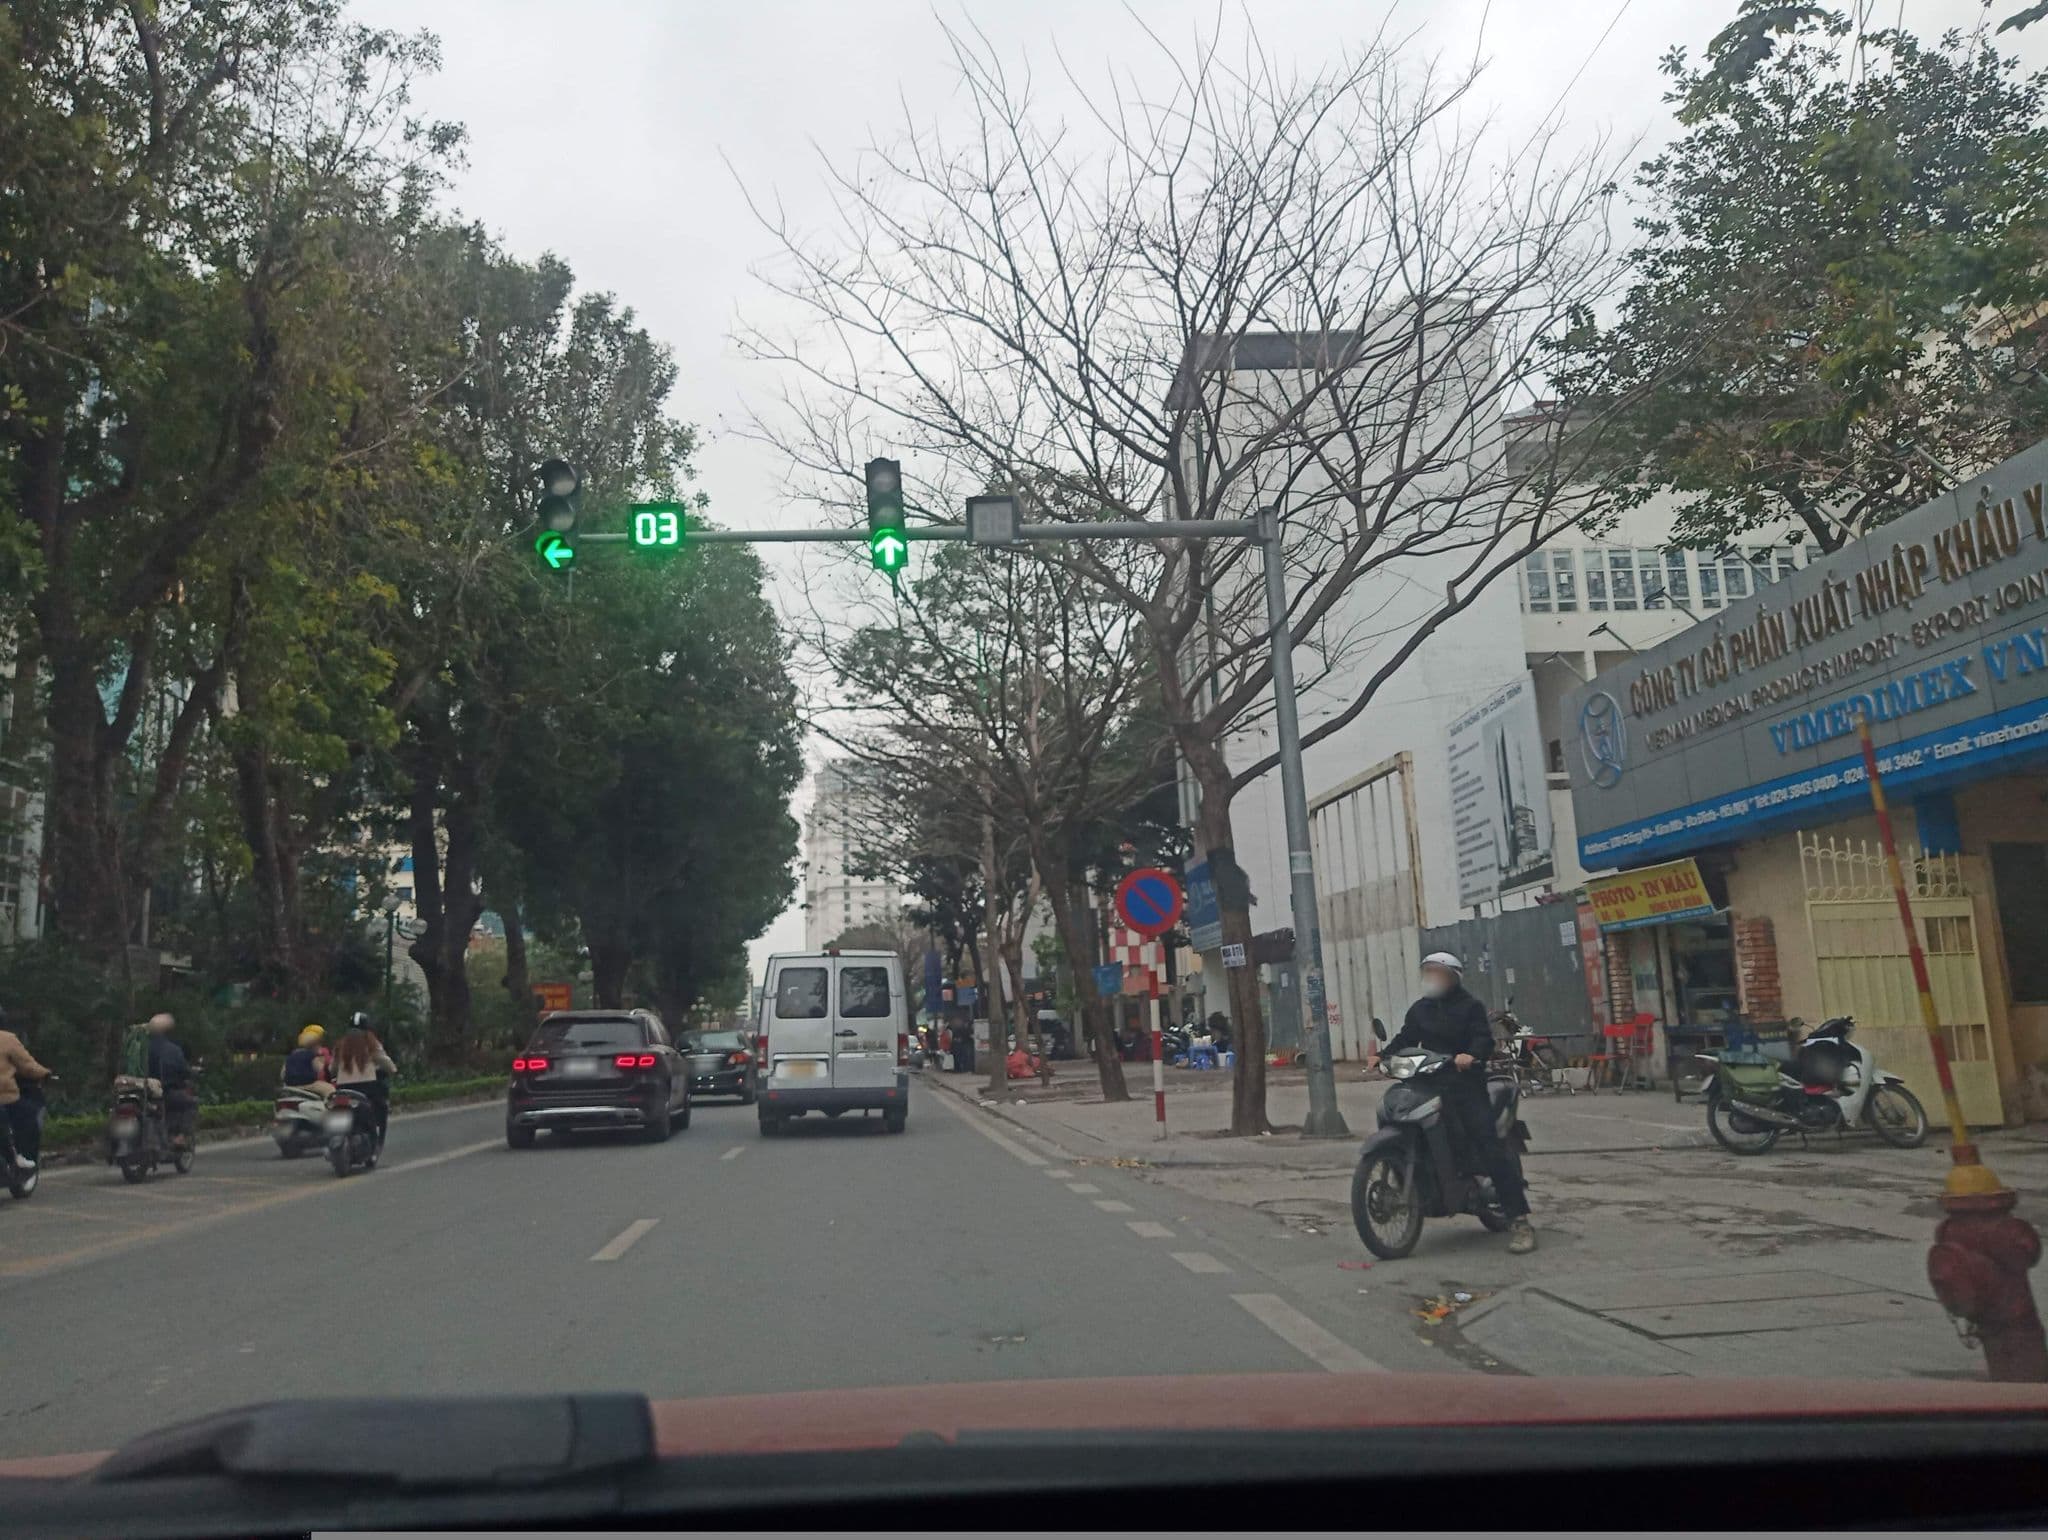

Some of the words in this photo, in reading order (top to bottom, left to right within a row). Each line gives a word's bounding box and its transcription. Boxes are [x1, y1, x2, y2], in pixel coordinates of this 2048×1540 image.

[635, 512, 678, 546] 03
[1631, 668, 1678, 719] CÔNG
[1677, 653, 1700, 697] TY
[1702, 618, 1730, 688] CỔ
[1729, 602, 1791, 675] PHẦN
[1790, 569, 1854, 649] XUẤT
[1855, 541, 1930, 621] NHẬP
[1933, 485, 2023, 586] KHẨU
[2022, 482, 2047, 541] Y
[1695, 693, 1751, 729] MEDICAL
[1751, 658, 1832, 712] PRODUCTS
[1832, 632, 1899, 676] IMPORT
[1911, 594, 1990, 648] EXPORT
[1590, 884, 1637, 909] PHOTO
